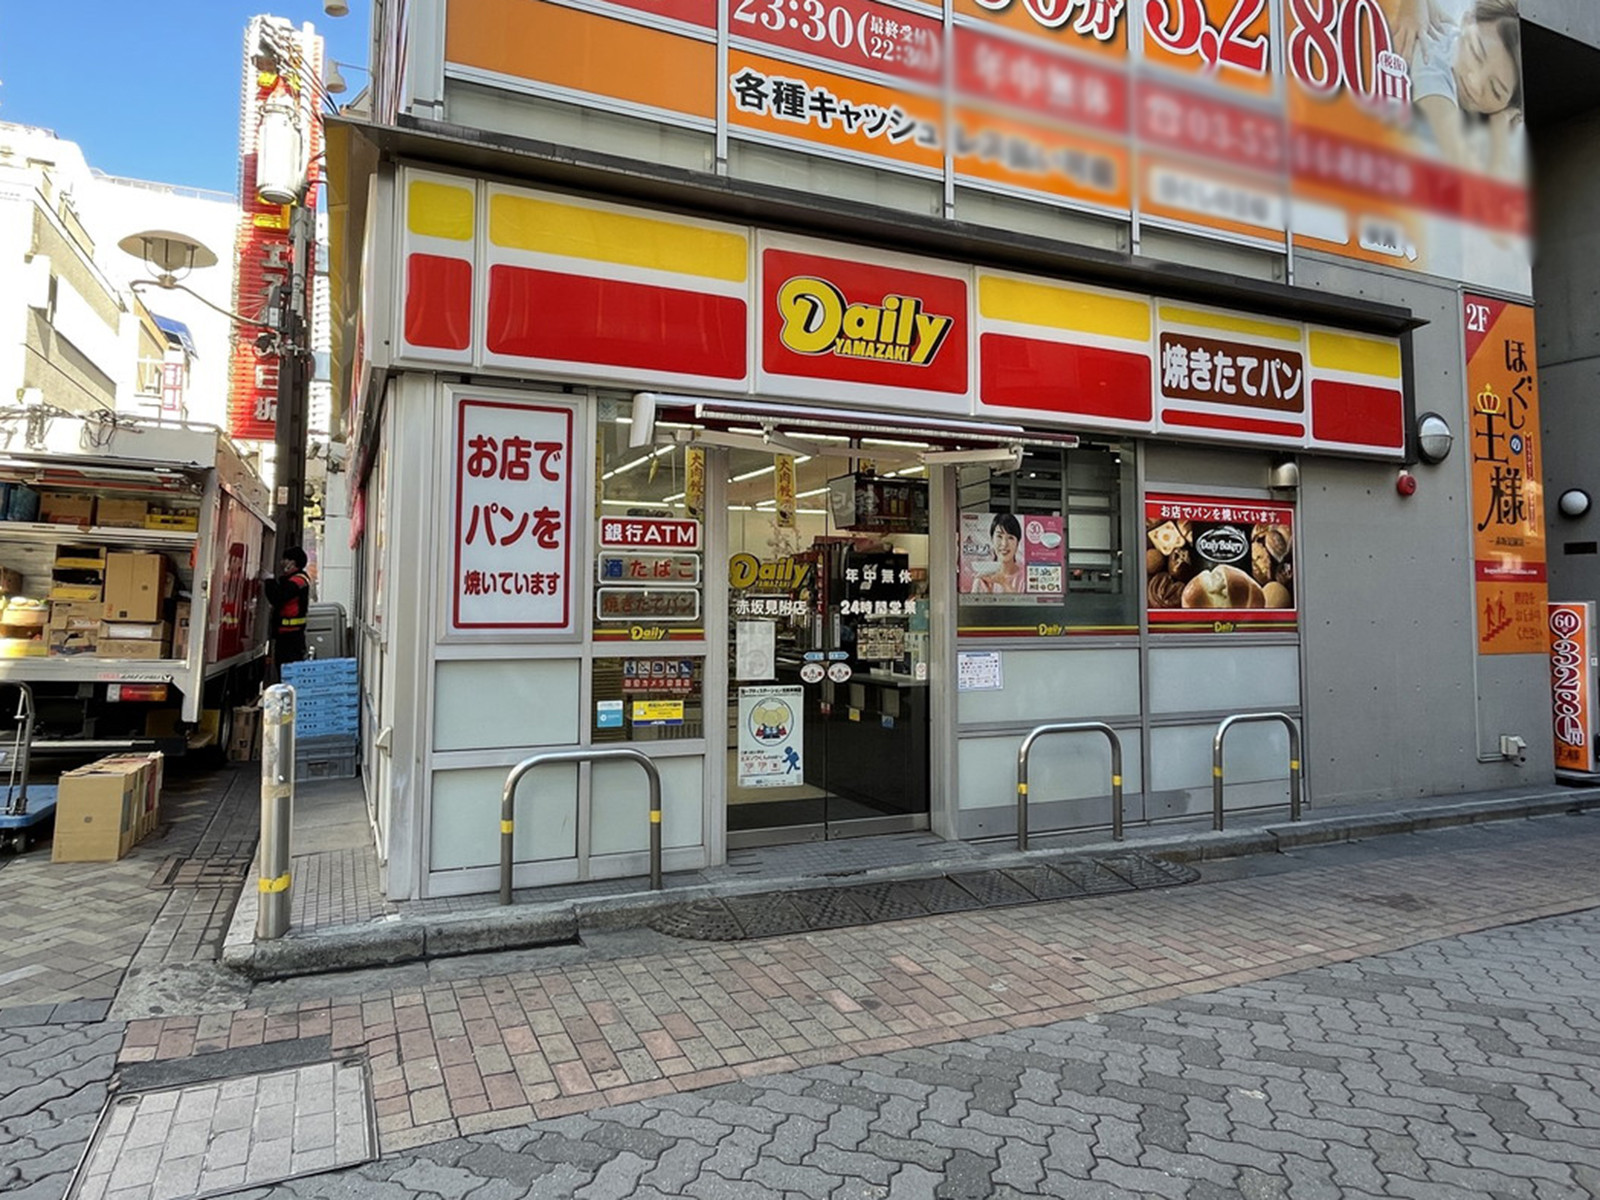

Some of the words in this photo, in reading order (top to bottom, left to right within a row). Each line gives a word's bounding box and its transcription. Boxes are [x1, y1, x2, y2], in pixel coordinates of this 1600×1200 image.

[777, 276, 954, 366] Daily
[1466, 303, 1491, 332] 2F
[836, 338, 909, 362] YAMAZAKI
[1163, 342, 1302, 400] 焼きたてパン
[467, 434, 563, 481] お店で
[465, 502, 561, 549] パンを
[1160, 505, 1280, 524] お店でパンを焼いています。
[604, 523, 694, 544] 銀行ATM
[630, 558, 694, 578] たばこ
[728, 552, 811, 590] Daily
[845, 568, 913, 584] 年中無休
[464, 570, 561, 595] 焼いています
[840, 600, 917, 616] 24時間営業
[1037, 623, 1063, 636] Daily
[1554, 614, 1576, 629] 60
[630, 626, 666, 640] Daily
